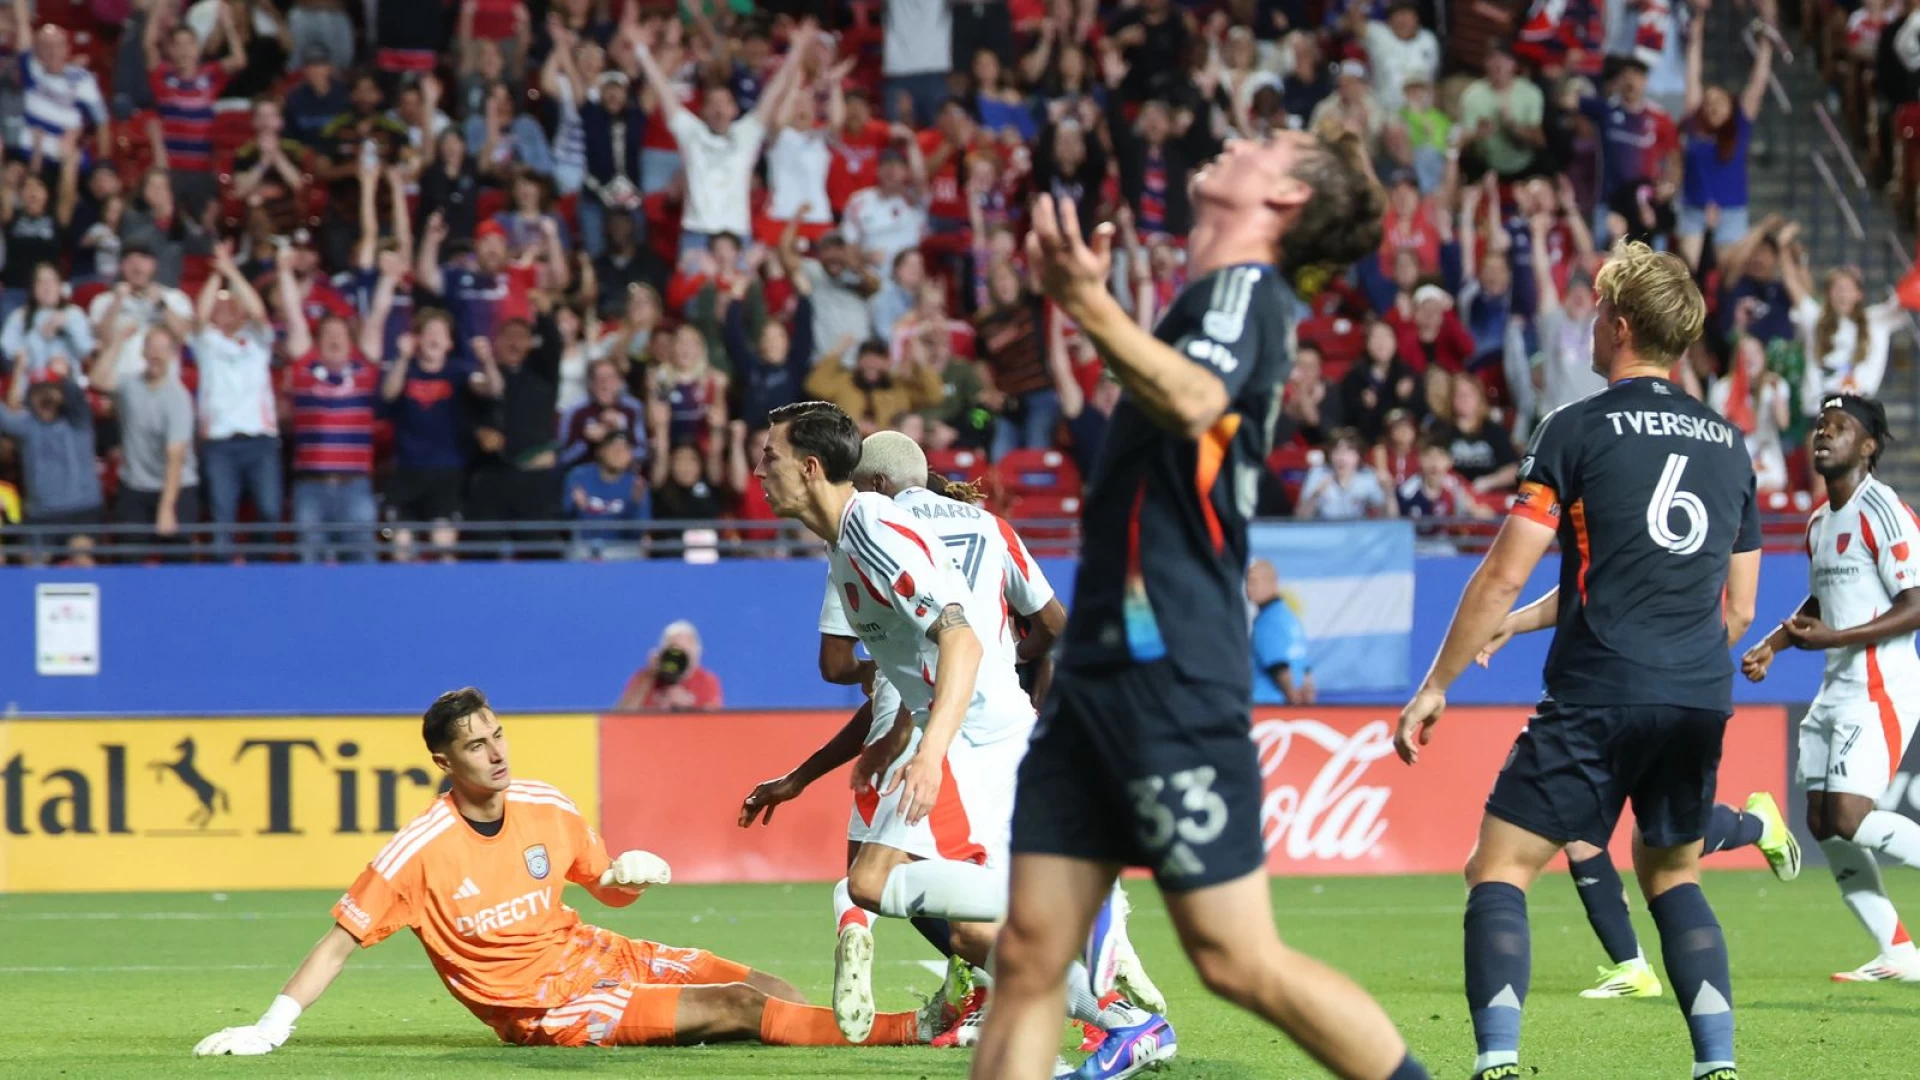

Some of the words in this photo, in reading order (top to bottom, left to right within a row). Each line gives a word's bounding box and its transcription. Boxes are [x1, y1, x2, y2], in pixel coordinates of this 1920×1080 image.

[1606, 411, 1733, 448] TVERSKOV
[1646, 453, 1709, 555] 6
[1840, 724, 1862, 756] 7
[0, 744, 134, 836] tal
[233, 738, 454, 836] Tir
[1127, 765, 1228, 850] 33
[1250, 719, 1394, 861] ola
[456, 886, 552, 936] DIRECTV
